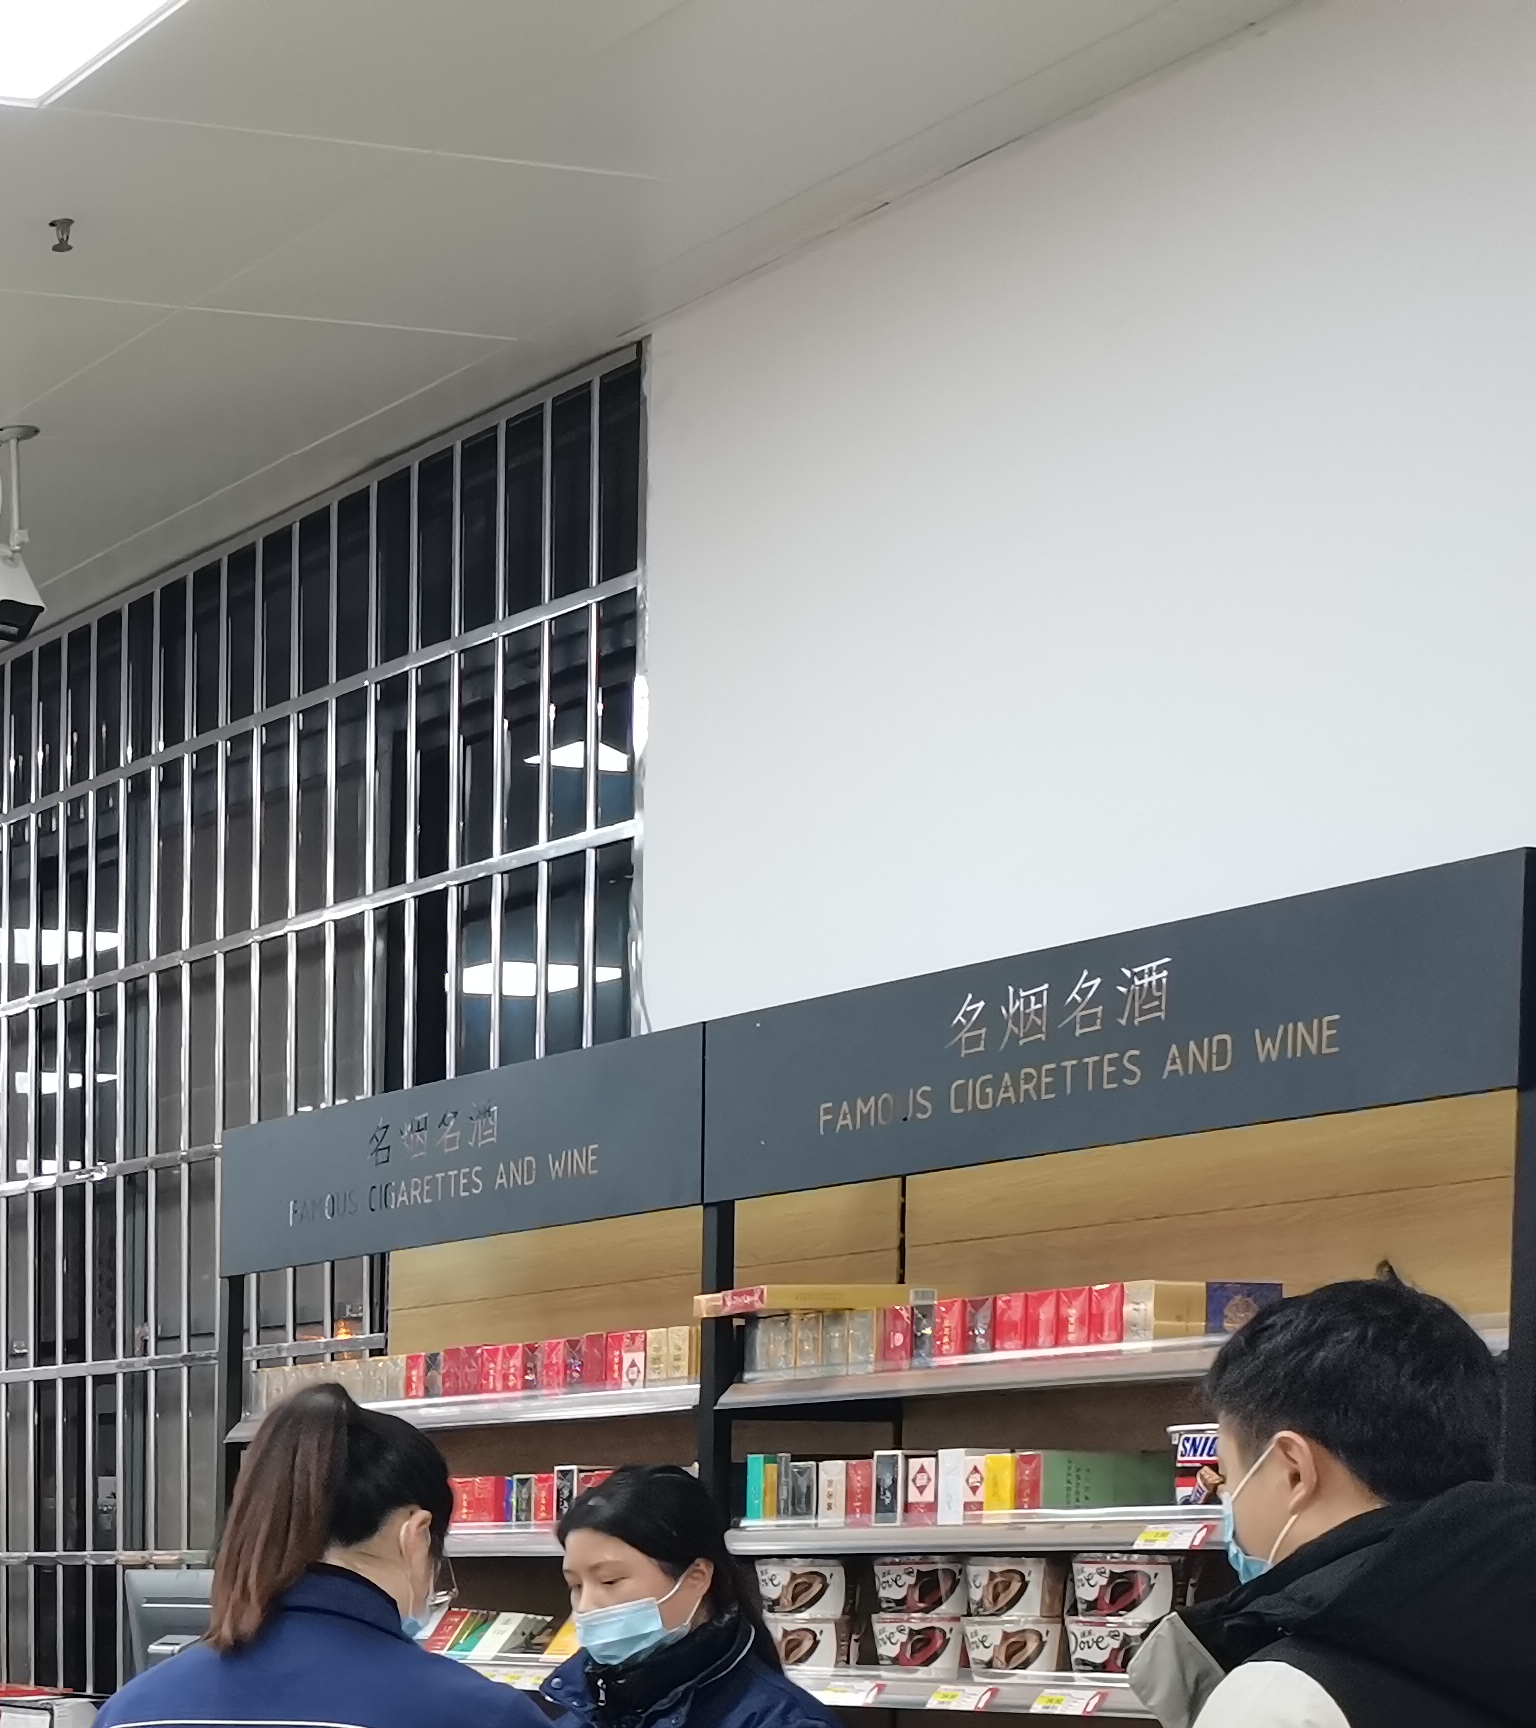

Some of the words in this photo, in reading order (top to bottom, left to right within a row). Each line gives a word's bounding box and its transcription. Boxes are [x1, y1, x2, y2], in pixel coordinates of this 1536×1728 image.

[944, 957, 1173, 1058] 名烟名酒
[949, 1049, 1142, 1115] CIGARETTES
[1161, 1033, 1233, 1080] AND
[1254, 1014, 1341, 1063] WINE
[367, 1098, 499, 1167] 名烟名酒
[288, 1193, 359, 1228] FAMOUS
[367, 1167, 484, 1213] CIGARETTES
[494, 1156, 536, 1190] AND
[547, 1143, 600, 1181] WINE
